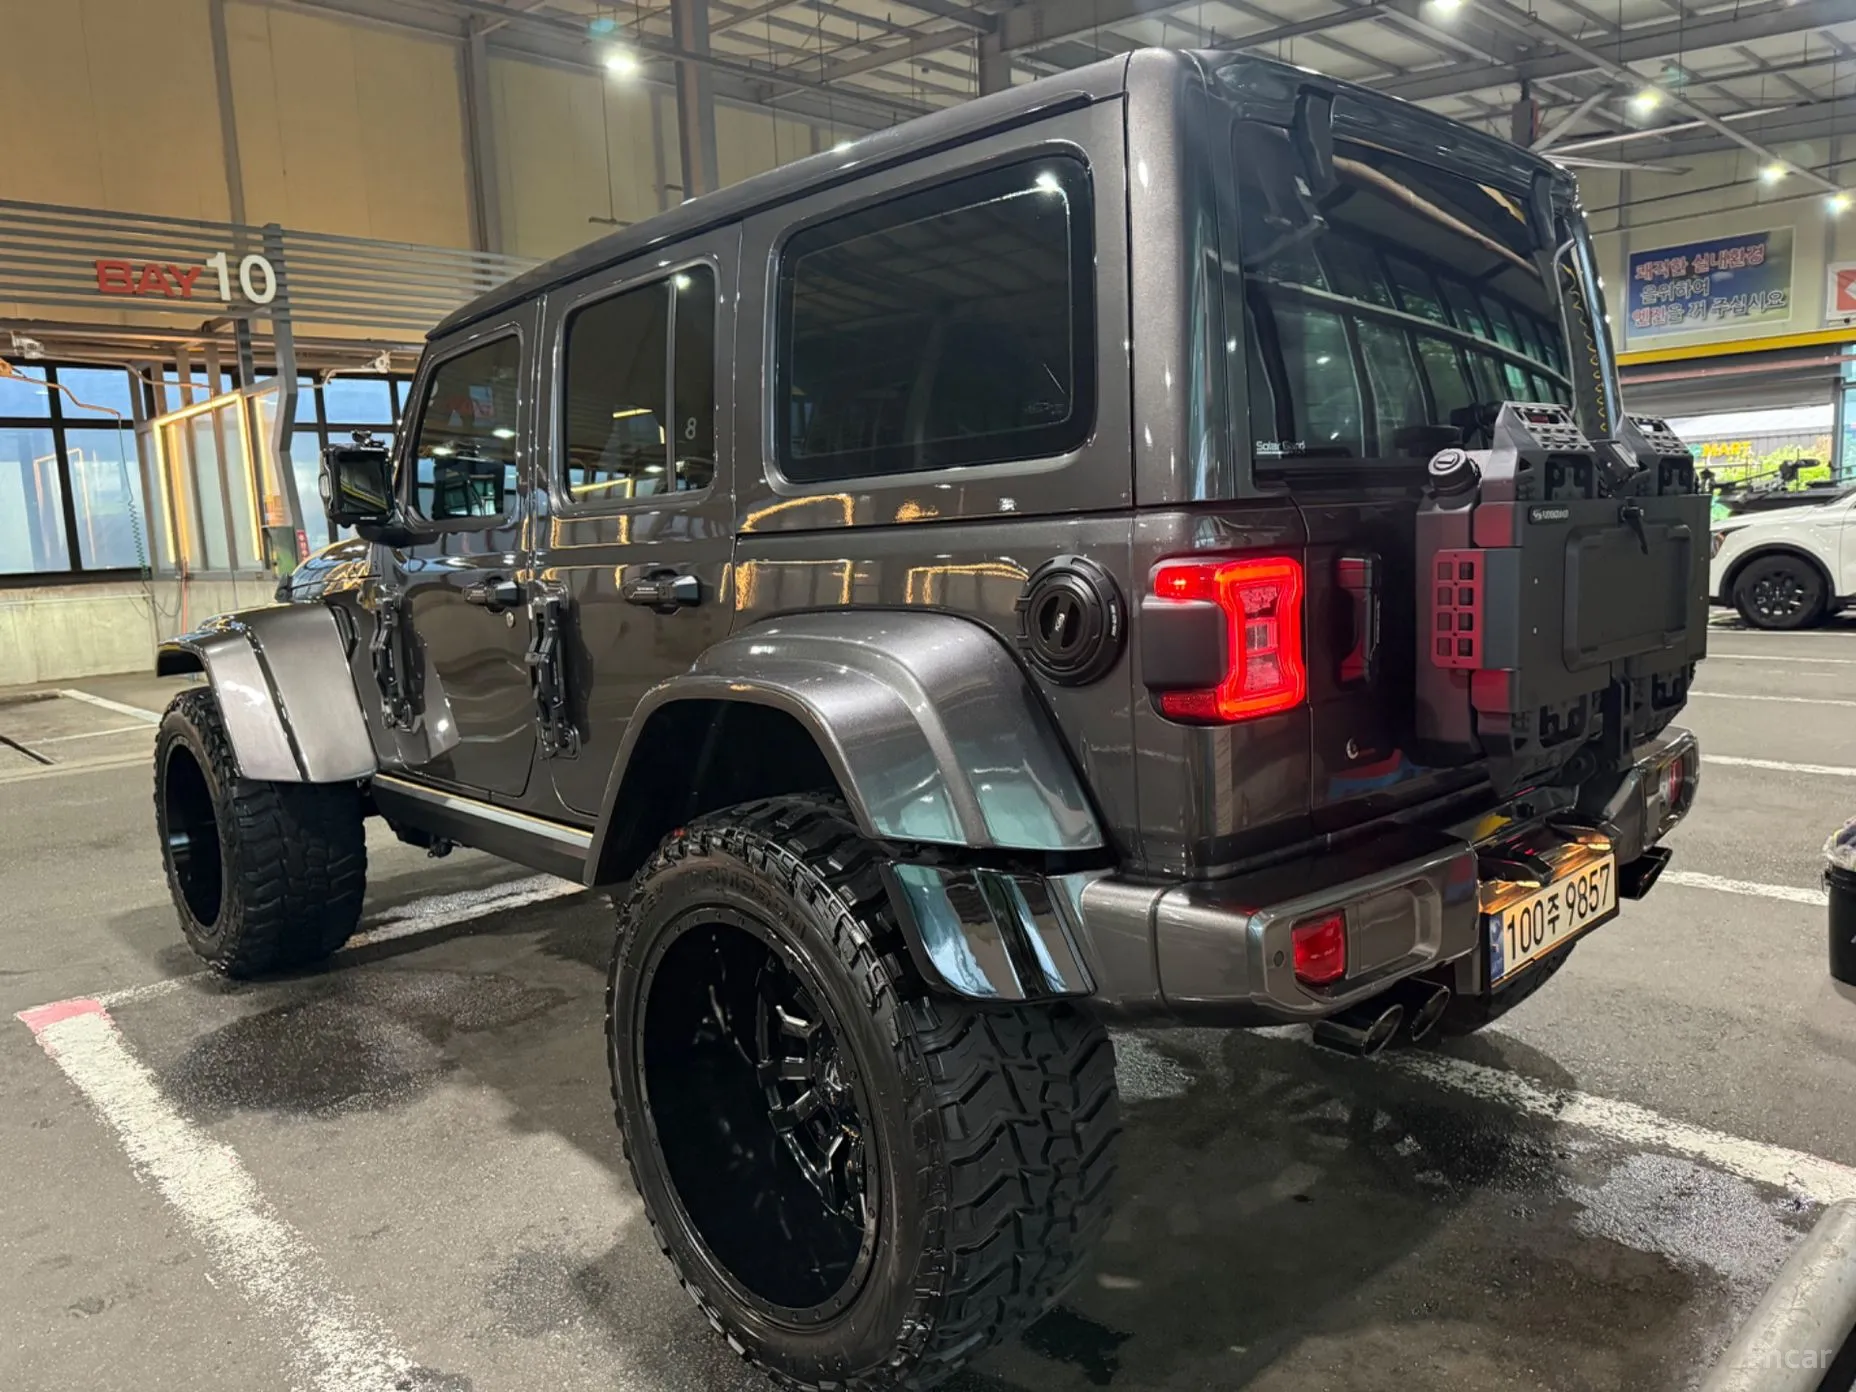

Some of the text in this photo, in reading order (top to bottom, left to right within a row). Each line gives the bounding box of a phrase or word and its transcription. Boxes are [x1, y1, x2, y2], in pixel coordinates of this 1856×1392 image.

[96, 251, 277, 304] BAY 10
[1635, 243, 1767, 281] 쾌적한 실내환경
[1688, 299, 1707, 321] 꺼
[1507, 863, 1611, 961] 100주 9857
